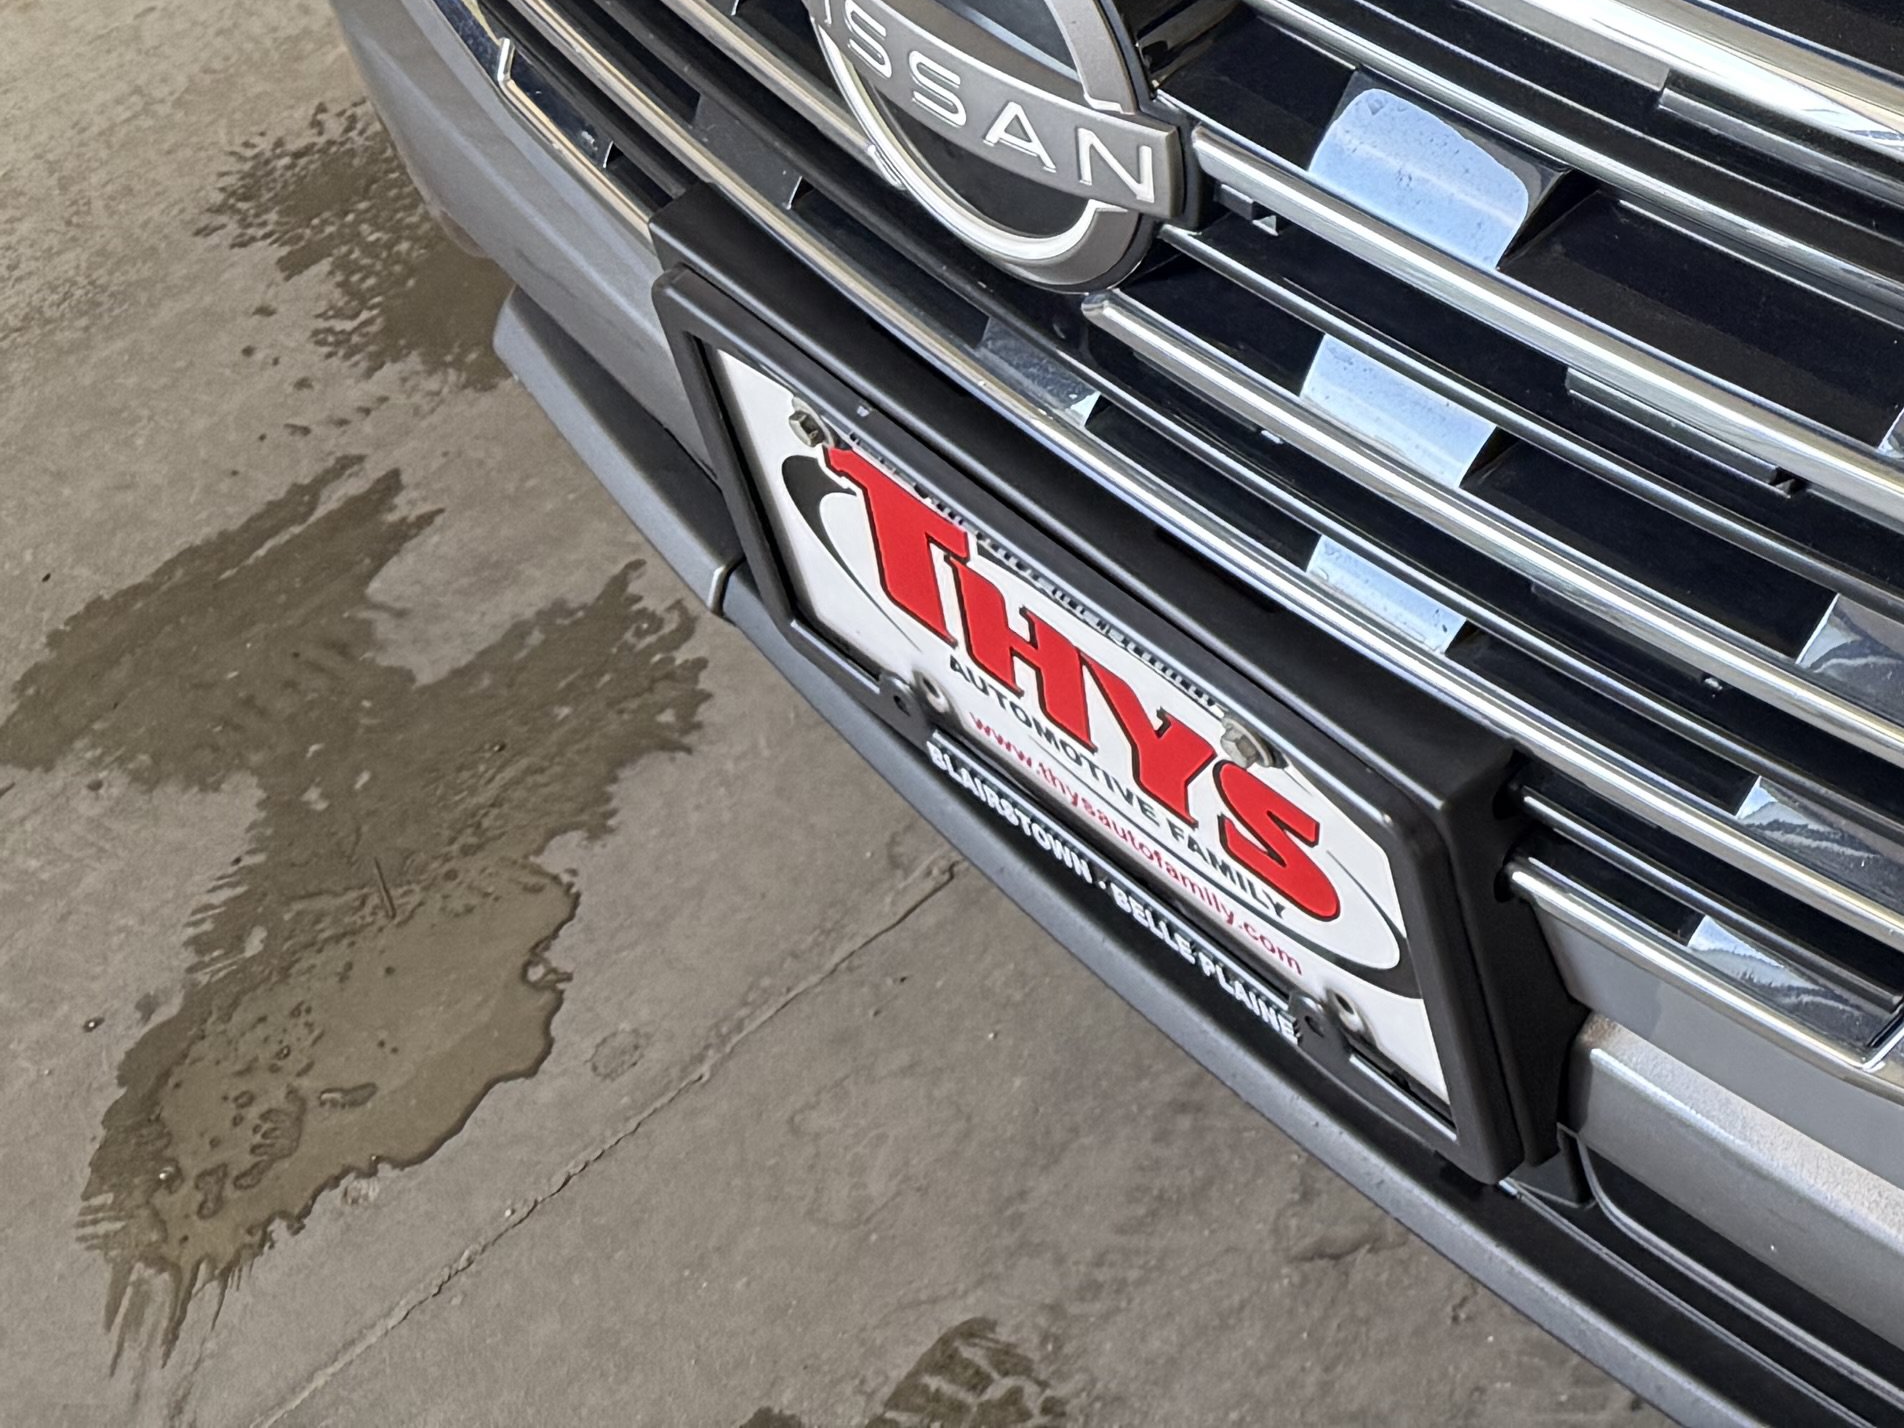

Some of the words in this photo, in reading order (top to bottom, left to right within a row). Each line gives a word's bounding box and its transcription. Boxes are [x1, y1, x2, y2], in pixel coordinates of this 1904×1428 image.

[823, 447, 1341, 922] THYS
[950, 654, 1160, 827] AUTOMOTIVE
[1167, 816, 1288, 919] FAMILY
[926, 740, 1093, 884] BLAIRSTOWN
[1111, 885, 1197, 965] BELLE
[1198, 950, 1301, 1045] PLAINE
[969, 712, 1302, 976] www.thysautofamily.com
